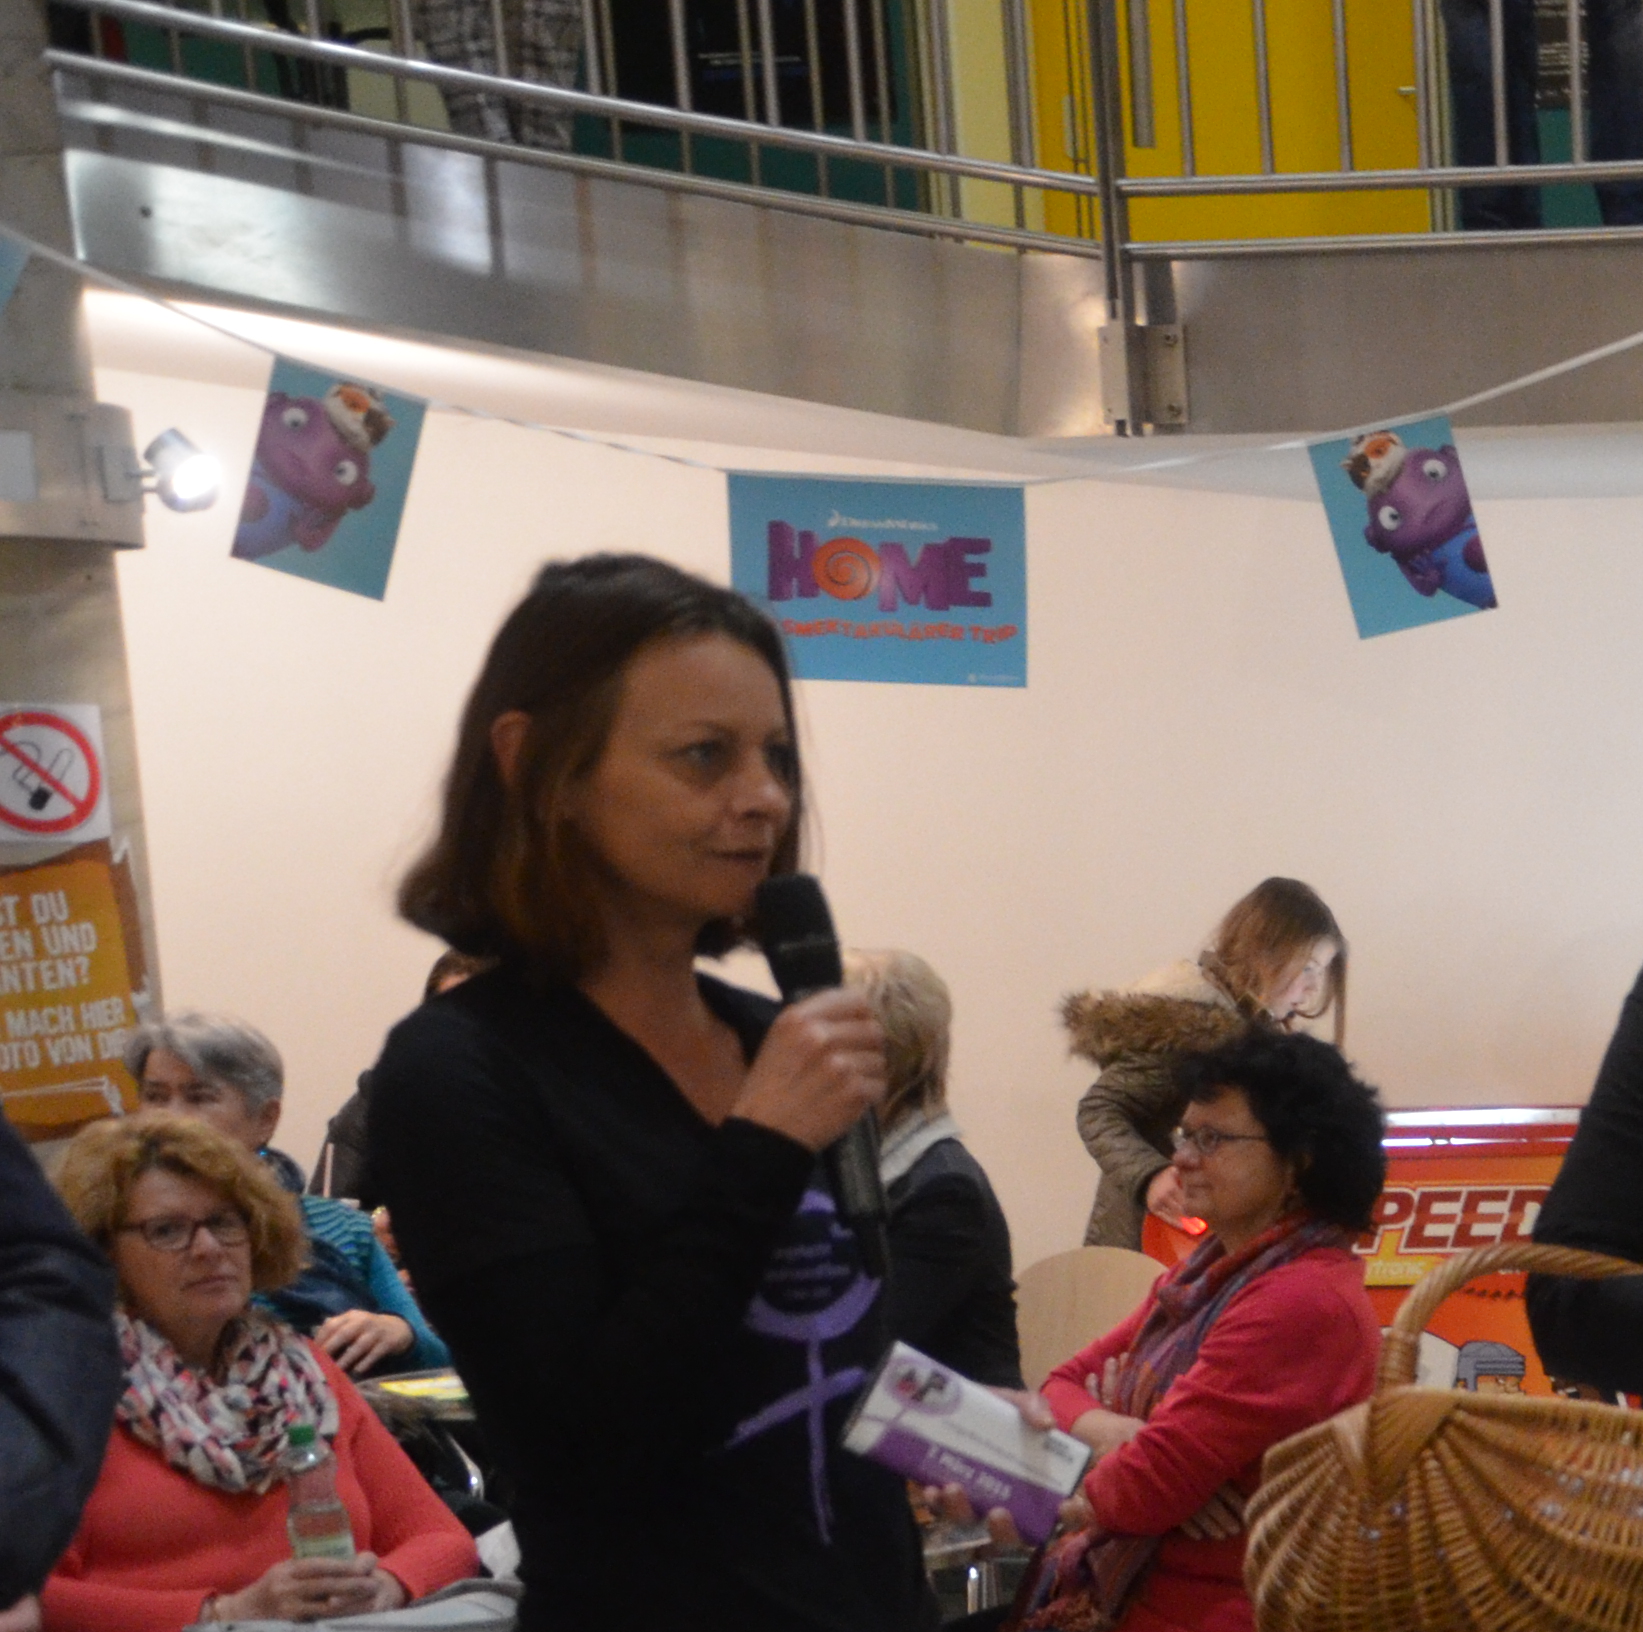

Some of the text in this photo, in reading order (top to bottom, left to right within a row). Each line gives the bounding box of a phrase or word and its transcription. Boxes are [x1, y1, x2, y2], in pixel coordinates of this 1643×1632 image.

[767, 520, 992, 614] HOME
[31, 888, 70, 925] DU
[41, 921, 97, 956] UND
[5, 1004, 76, 1038] MACH
[45, 1033, 94, 1067] VON
[1360, 1186, 1552, 1253] PEED
